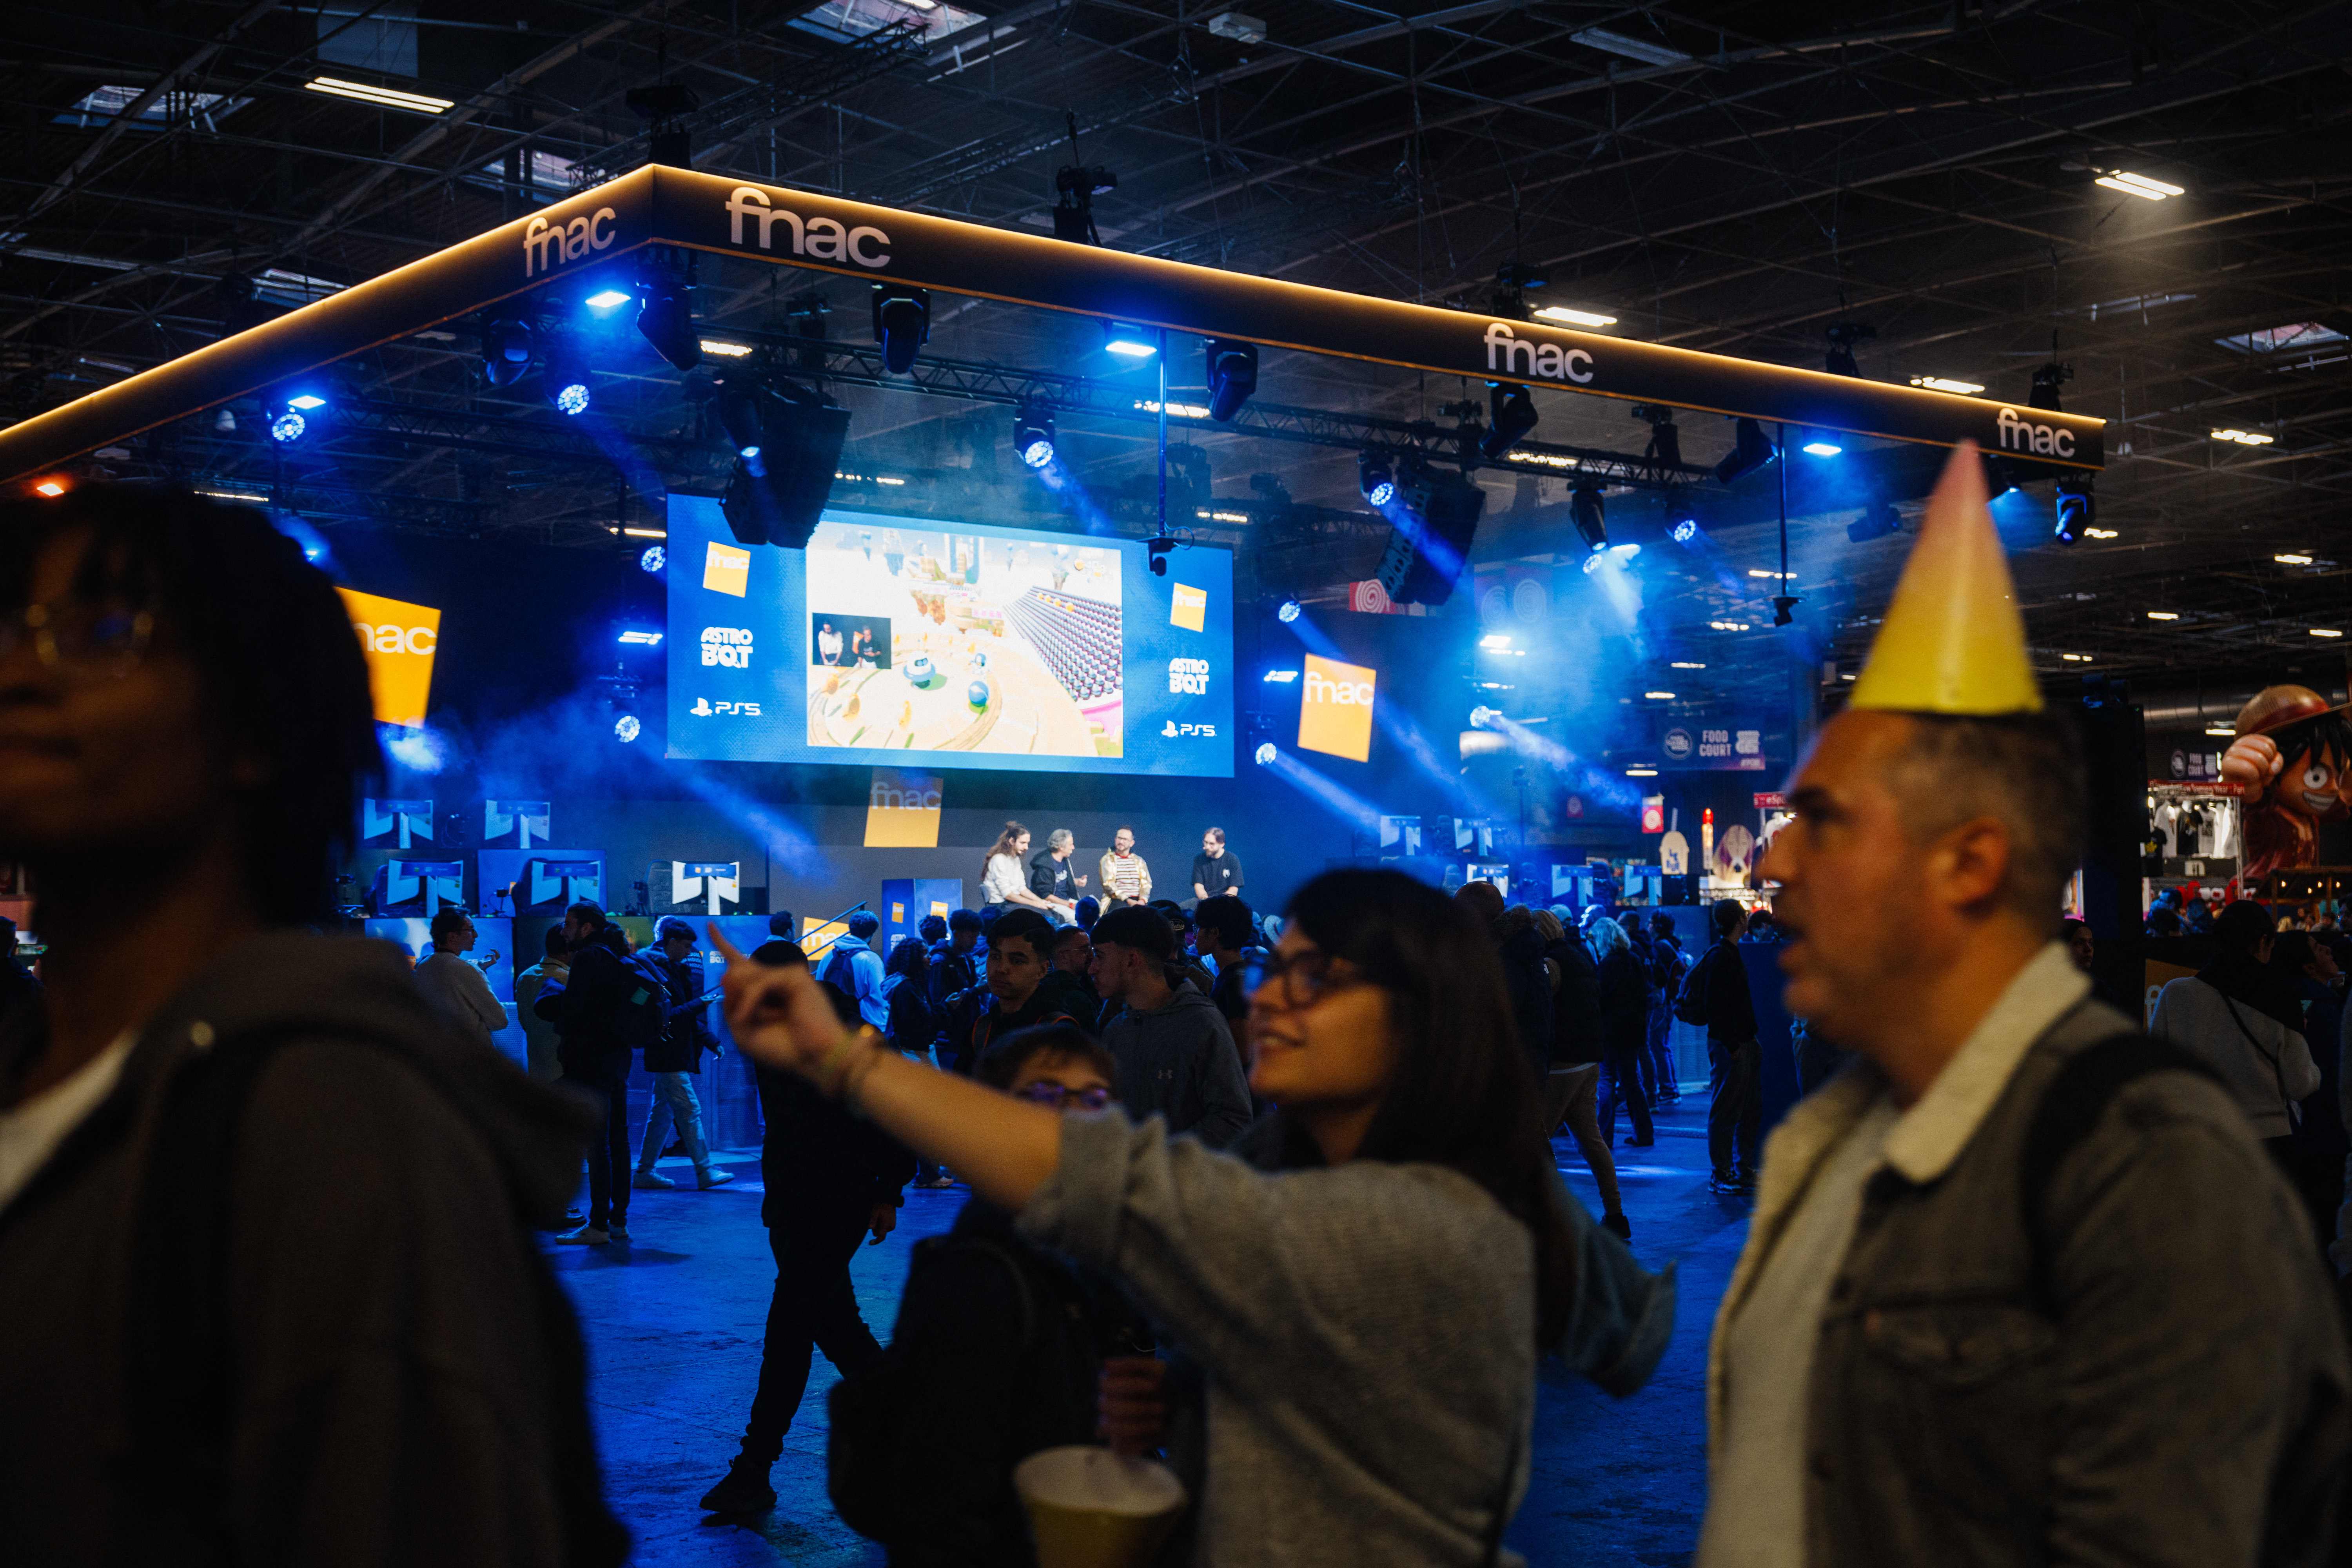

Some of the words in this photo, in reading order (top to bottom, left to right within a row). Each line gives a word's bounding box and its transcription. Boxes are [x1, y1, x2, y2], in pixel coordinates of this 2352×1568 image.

[725, 187, 891, 268] fnac
[523, 207, 616, 278] fnac
[1483, 322, 1593, 383] fnac
[1996, 407, 2075, 458] fnac
[706, 549, 750, 570] fnac
[354, 622, 437, 655] nac
[701, 626, 753, 646] ASTRO
[701, 643, 753, 668] BOT
[1169, 658, 1209, 675] ASTRO
[1169, 674, 1209, 695] BOT
[1303, 671, 1375, 706] fnac
[715, 701, 760, 716] PS5
[1180, 723, 1215, 737] PS5
[1702, 730, 1729, 743] FOOD
[1699, 743, 1732, 757] COURT
[871, 781, 941, 811] fnac
